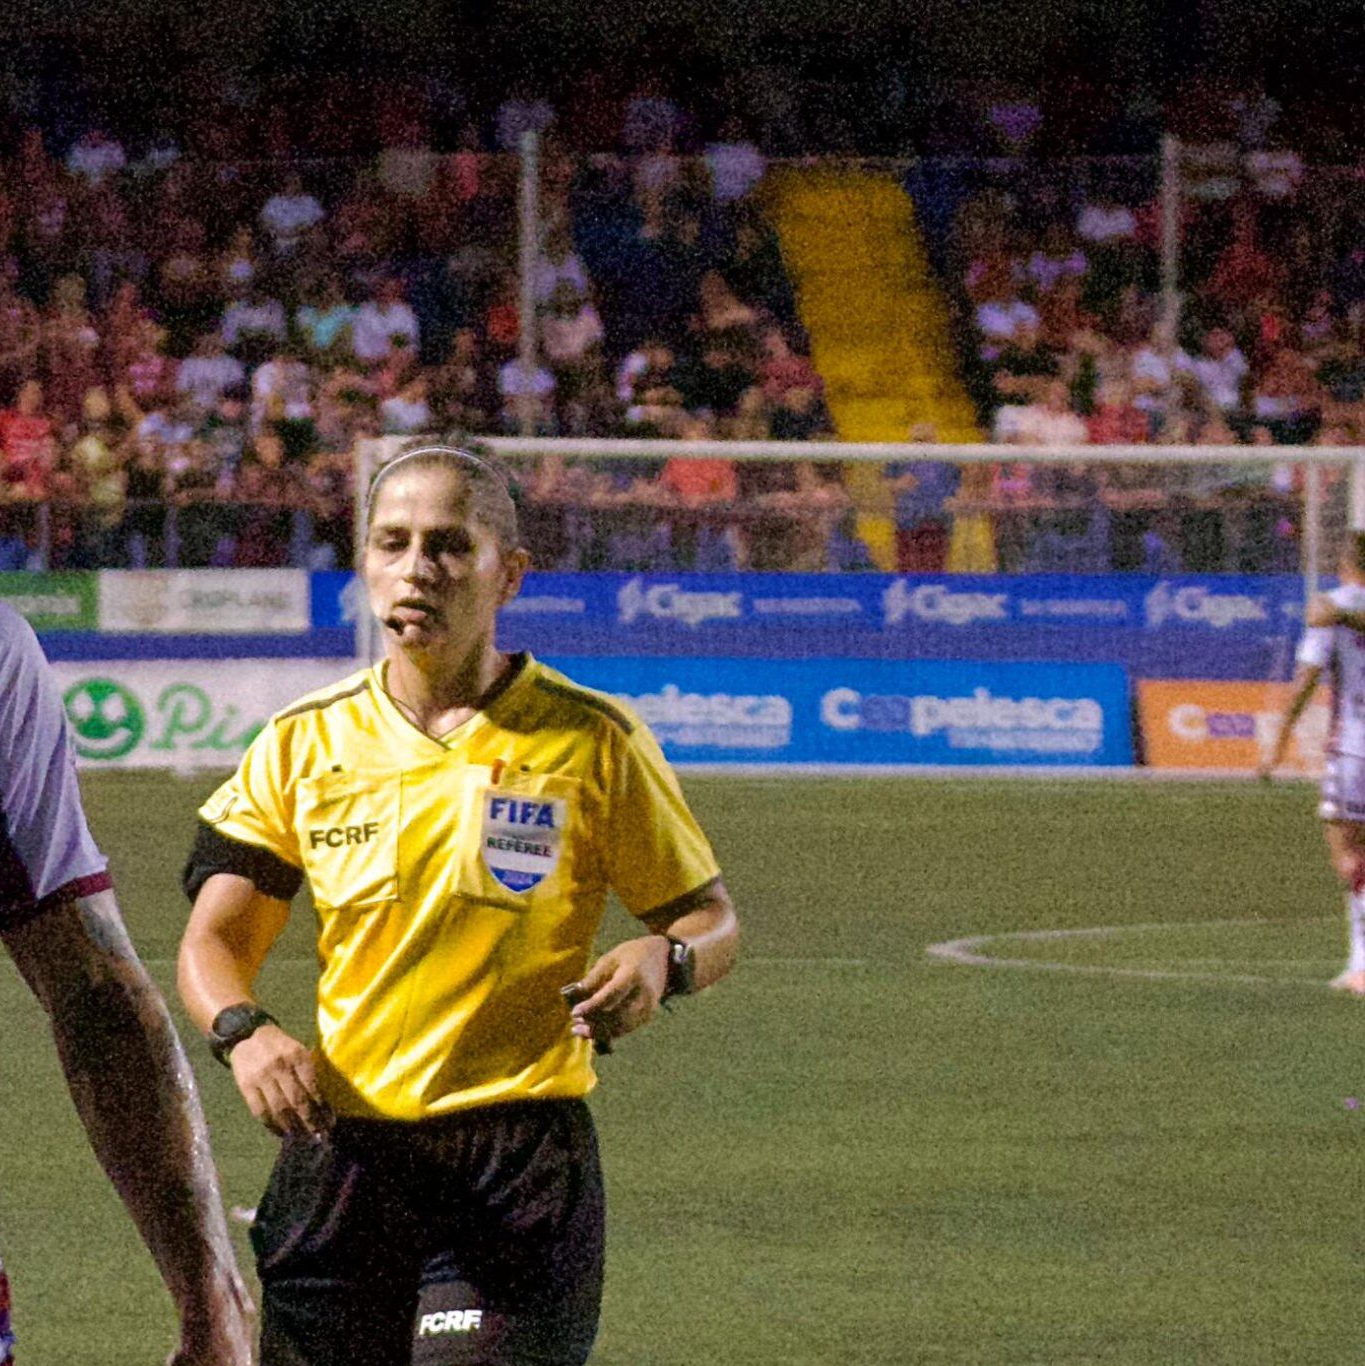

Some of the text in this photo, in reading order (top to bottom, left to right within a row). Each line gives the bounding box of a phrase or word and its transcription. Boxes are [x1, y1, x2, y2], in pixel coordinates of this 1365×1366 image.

[490, 797, 555, 828] FIFA
[309, 822, 379, 849] FCRF
[487, 836, 552, 858] REFEREE
[419, 1308, 483, 1336] FCRF
